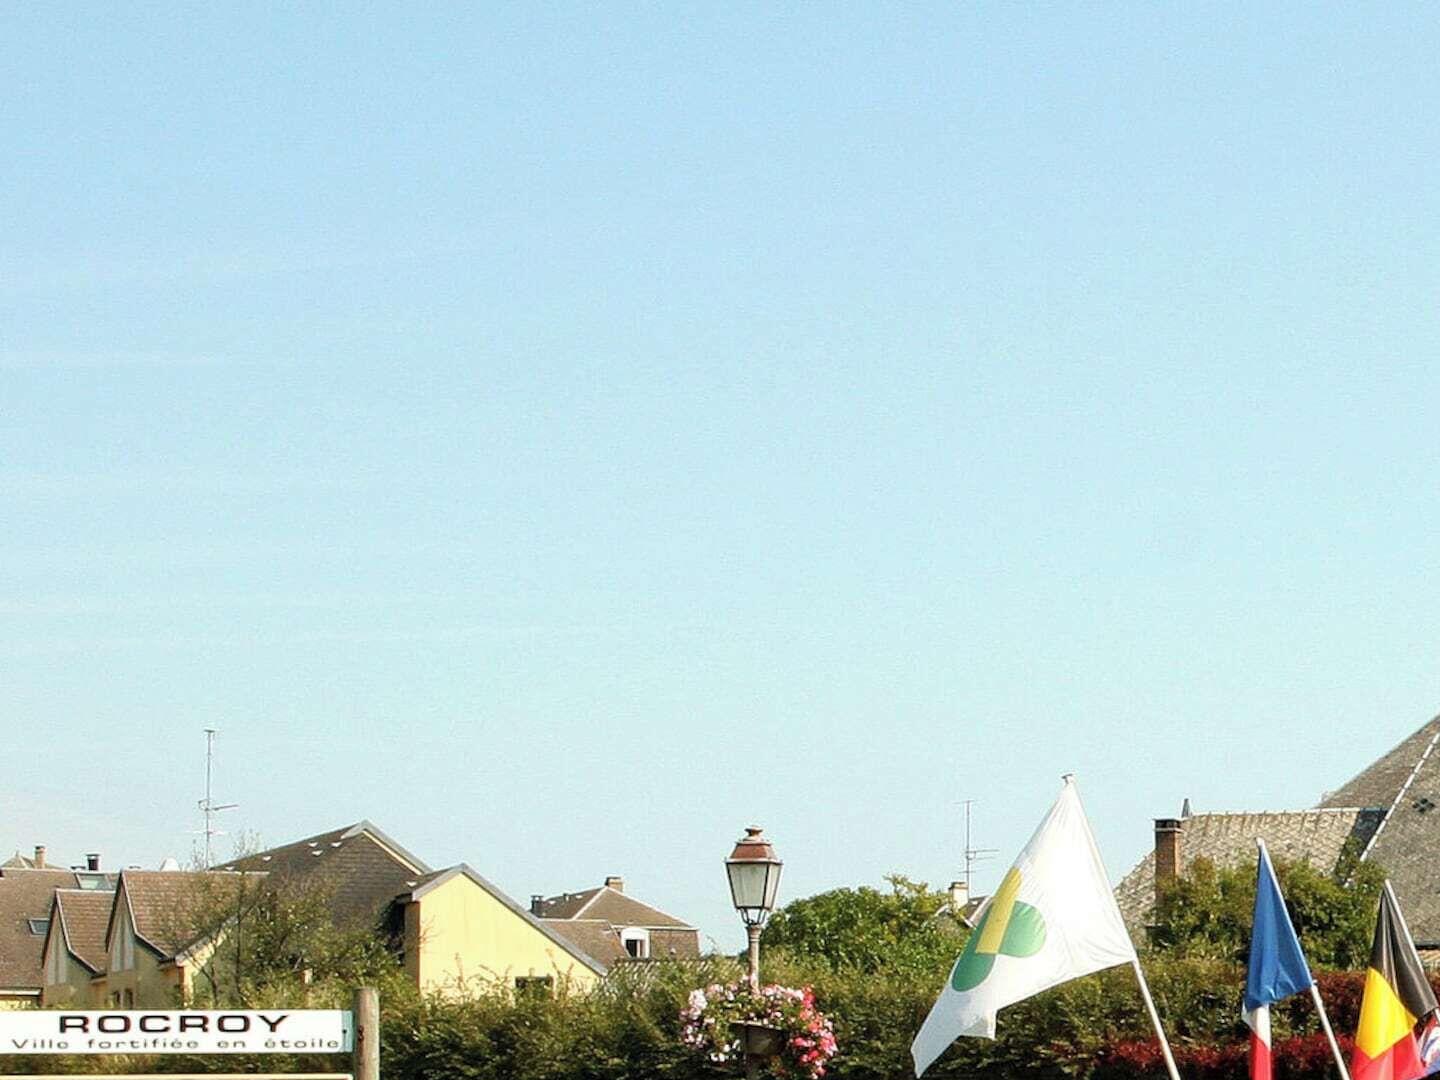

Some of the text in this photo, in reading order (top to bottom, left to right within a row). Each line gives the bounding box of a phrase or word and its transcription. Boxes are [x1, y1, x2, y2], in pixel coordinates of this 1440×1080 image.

[59, 1014, 290, 1034] ROCROY
[12, 1038, 340, 1049] Ville fortifiée en étoile
